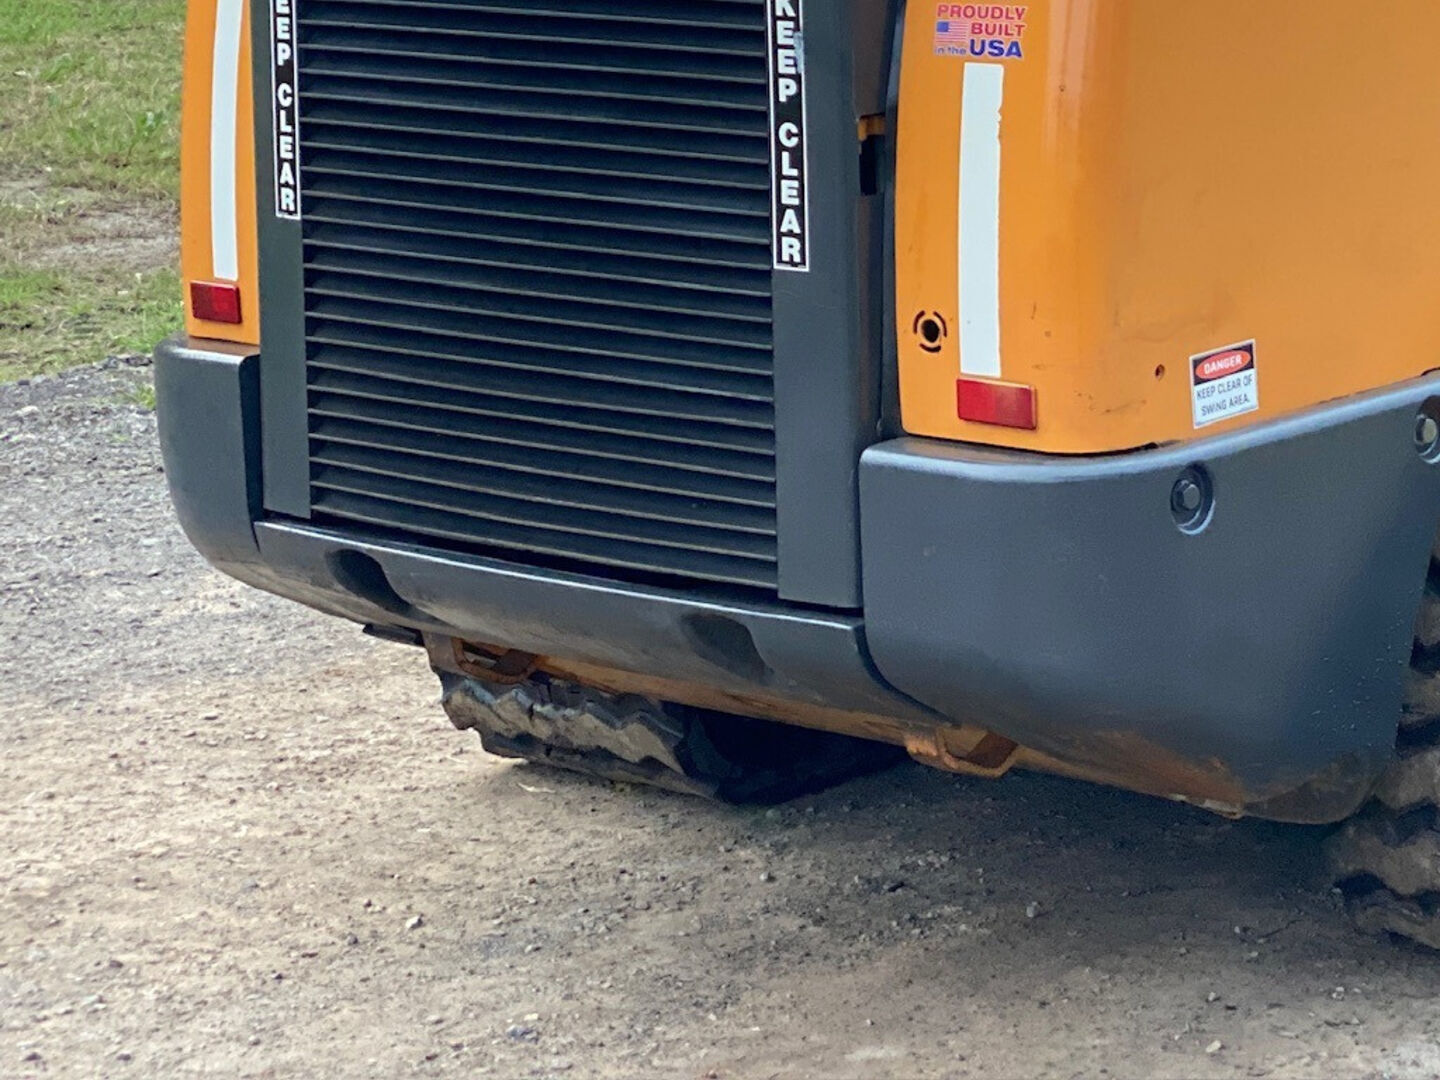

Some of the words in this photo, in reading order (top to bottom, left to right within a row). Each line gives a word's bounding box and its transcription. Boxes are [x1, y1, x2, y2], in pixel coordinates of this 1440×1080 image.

[937, 4, 1025, 20] PROUDLY
[971, 21, 1025, 37] BUILT
[969, 38, 1023, 58] USA
[277, 82, 296, 212] CLEAR
[778, 123, 801, 263] CLEAR
[1204, 355, 1242, 374] DANGER
[1197, 385, 1215, 400] KEEP
[1218, 378, 1241, 393] CLEAR
[1243, 374, 1252, 386] OF
[1201, 400, 1227, 416] SWING
[1229, 394, 1249, 407] AREA
